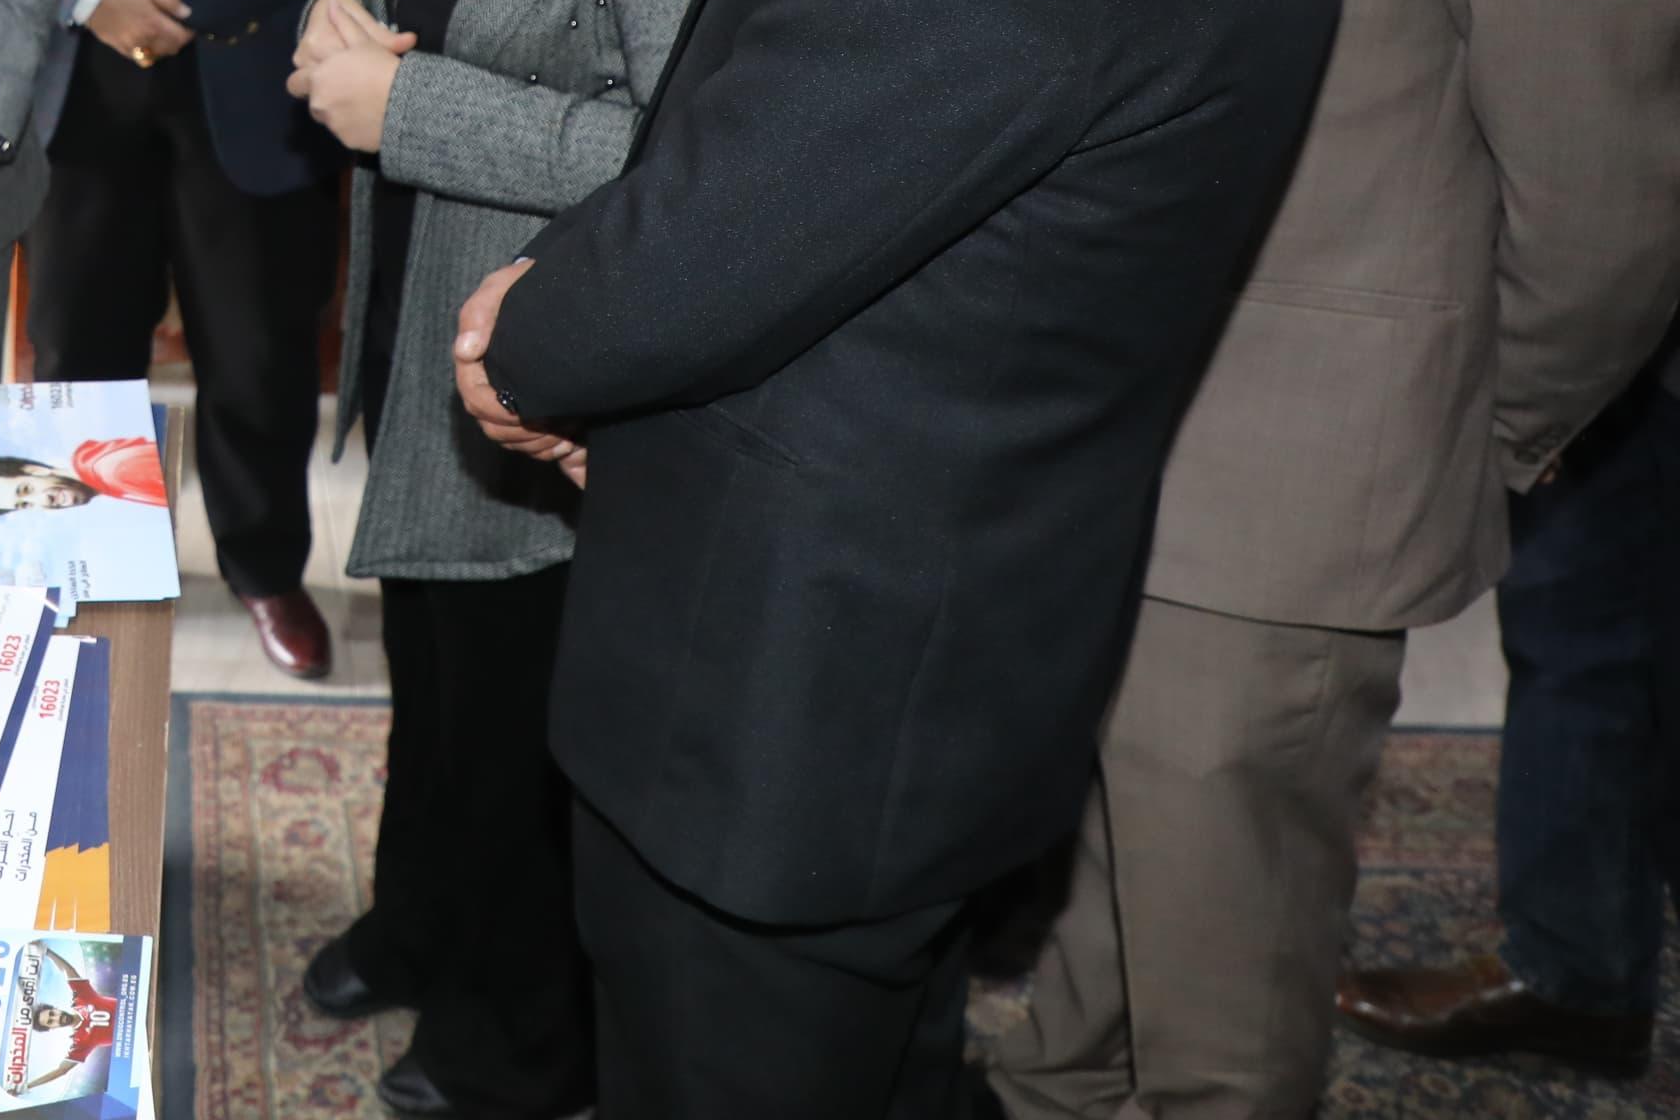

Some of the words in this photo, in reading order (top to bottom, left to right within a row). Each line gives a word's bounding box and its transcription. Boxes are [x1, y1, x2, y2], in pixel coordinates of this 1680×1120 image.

[39, 680, 61, 718] 16023
[25, 811, 38, 837] من
[15, 838, 33, 882] المخدرات
[89, 1010, 111, 1027] 10
[6, 1027, 28, 1085] المخدرات
